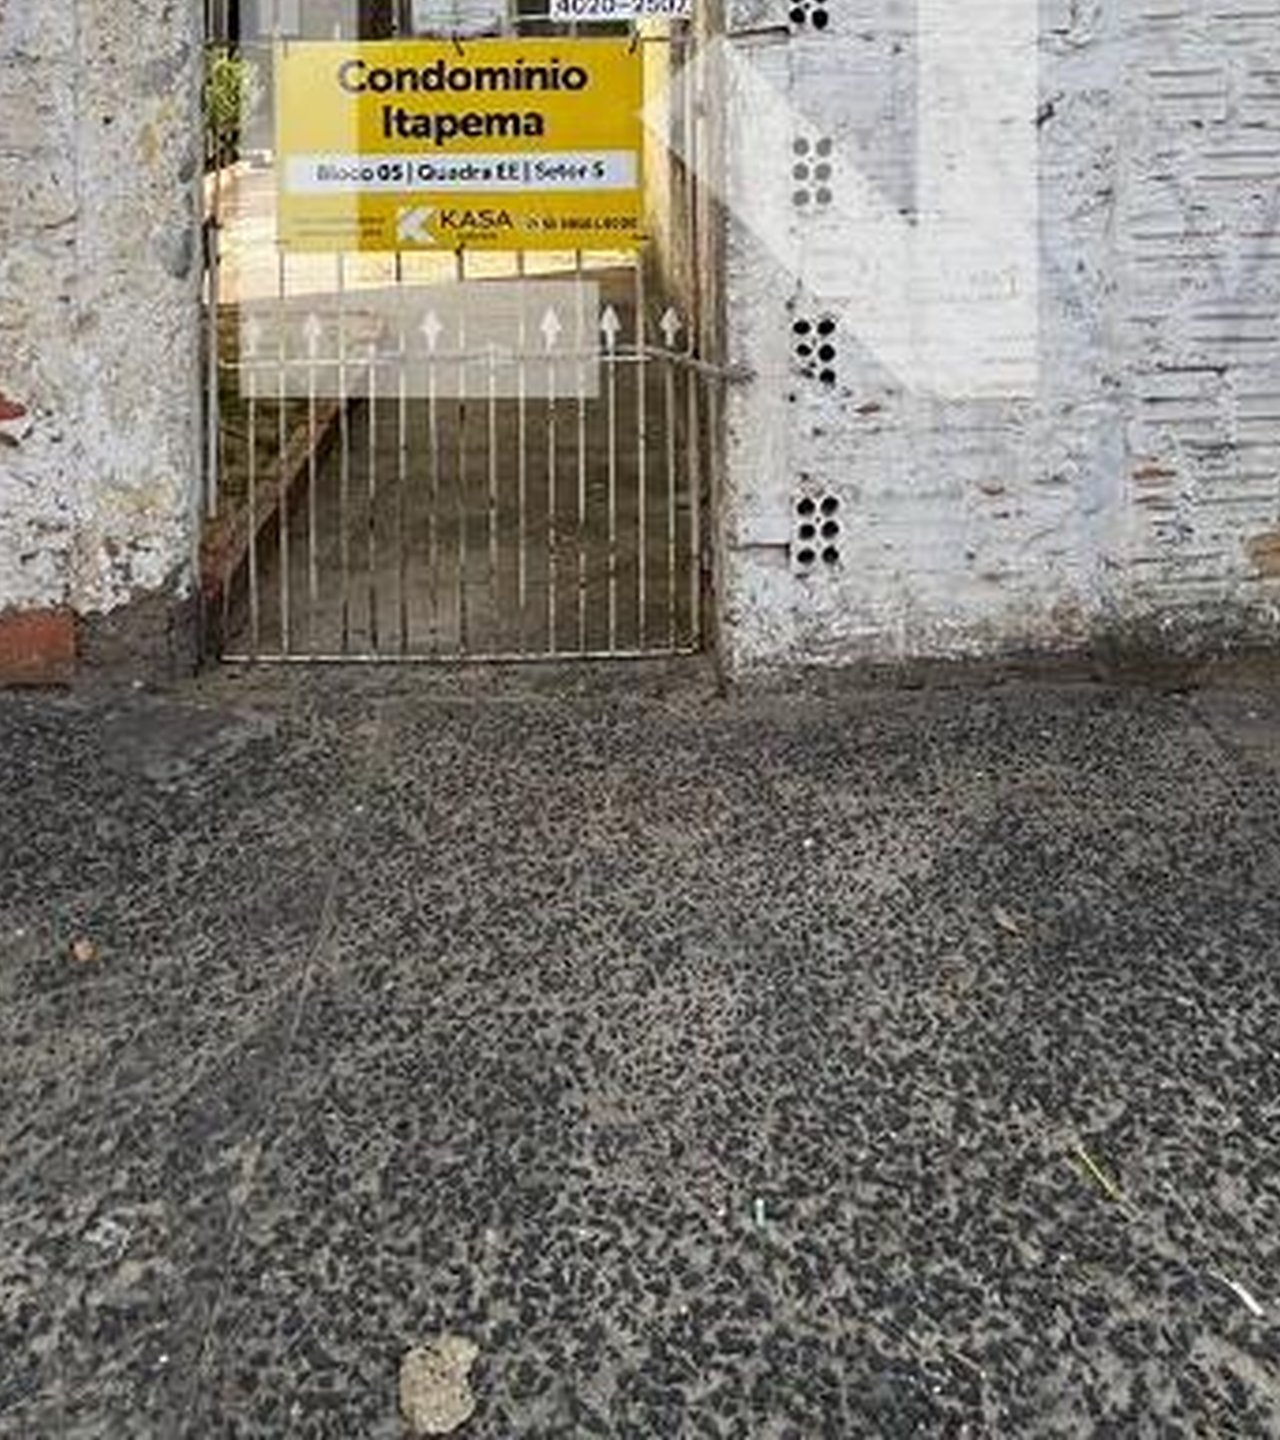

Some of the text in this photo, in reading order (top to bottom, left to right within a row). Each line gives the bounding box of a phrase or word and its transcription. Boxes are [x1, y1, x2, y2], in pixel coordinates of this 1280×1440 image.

[382, 105, 545, 146] Itapema
[376, 163, 404, 181] 05
[417, 162, 492, 182] Quadra
[439, 209, 513, 230] KASA
